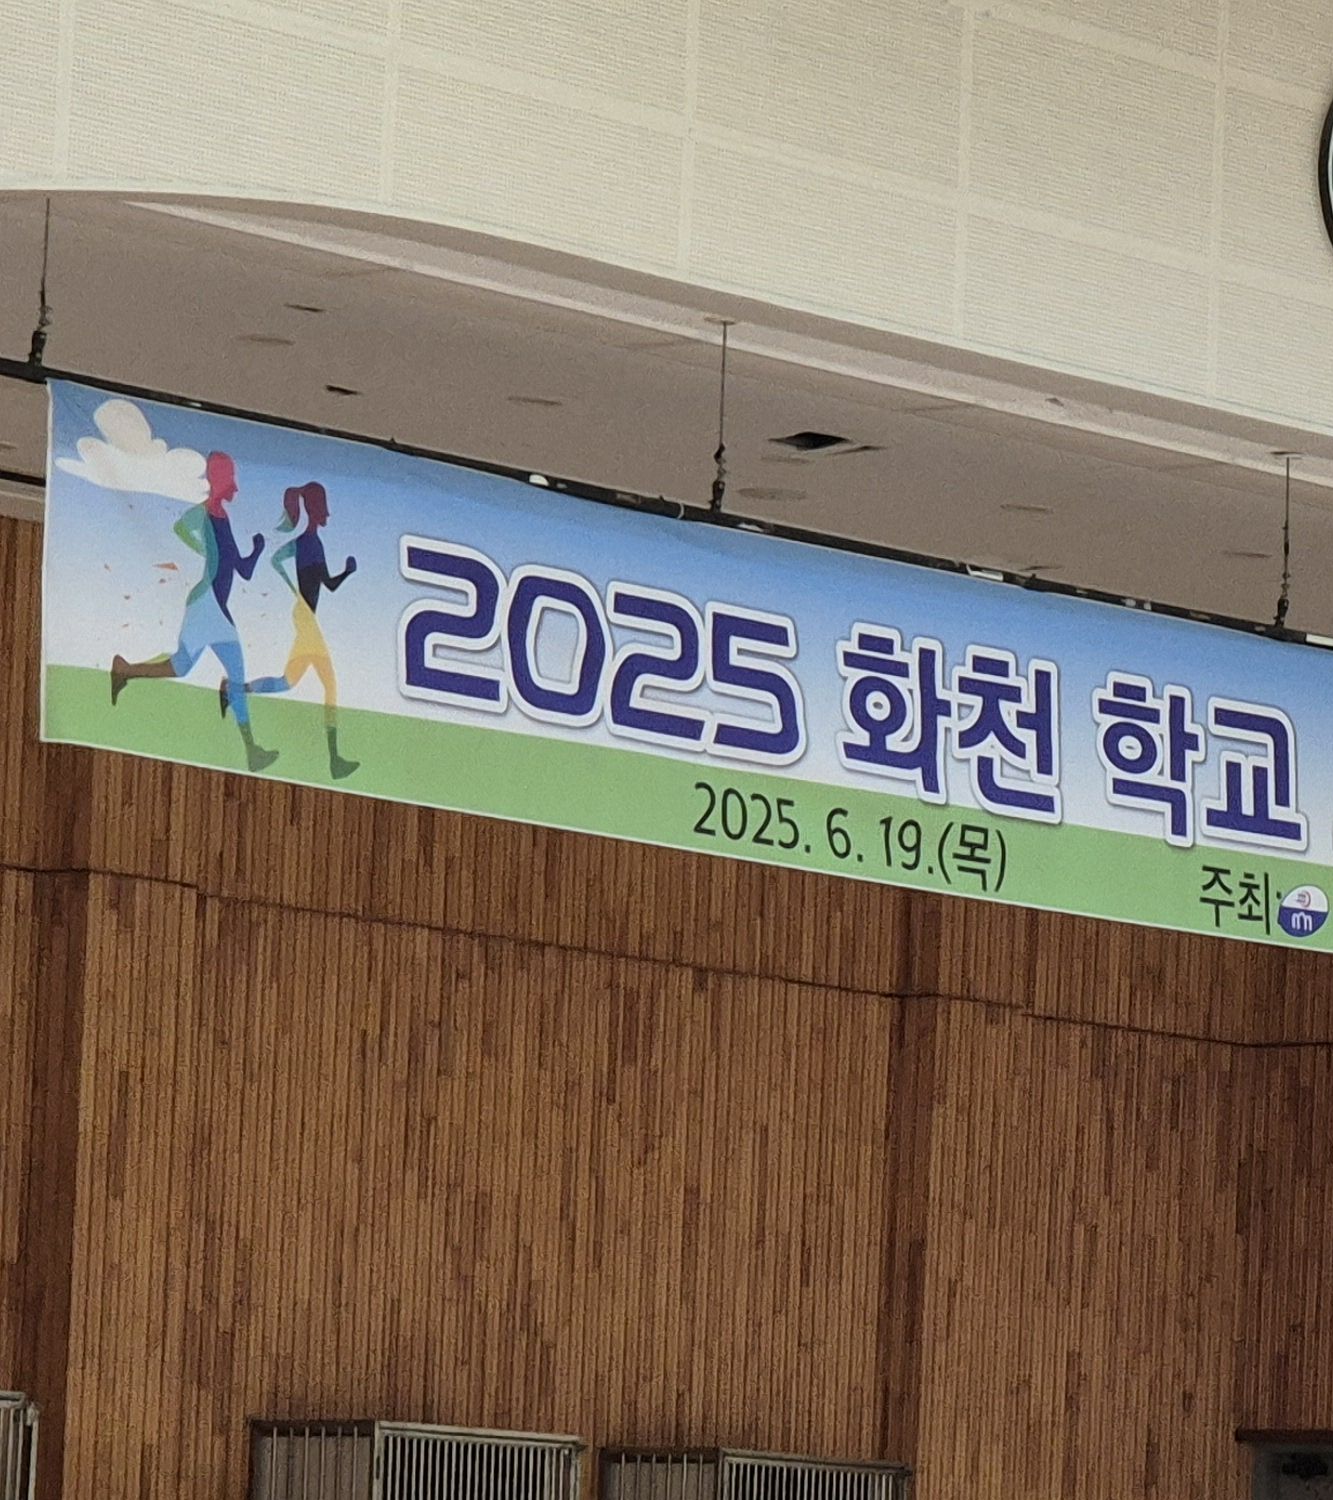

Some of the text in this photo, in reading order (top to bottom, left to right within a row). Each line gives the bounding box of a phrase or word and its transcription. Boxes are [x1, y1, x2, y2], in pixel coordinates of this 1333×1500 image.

[403, 546, 801, 756] 2025
[841, 631, 1057, 815] 화천
[1096, 680, 1304, 843] 학교
